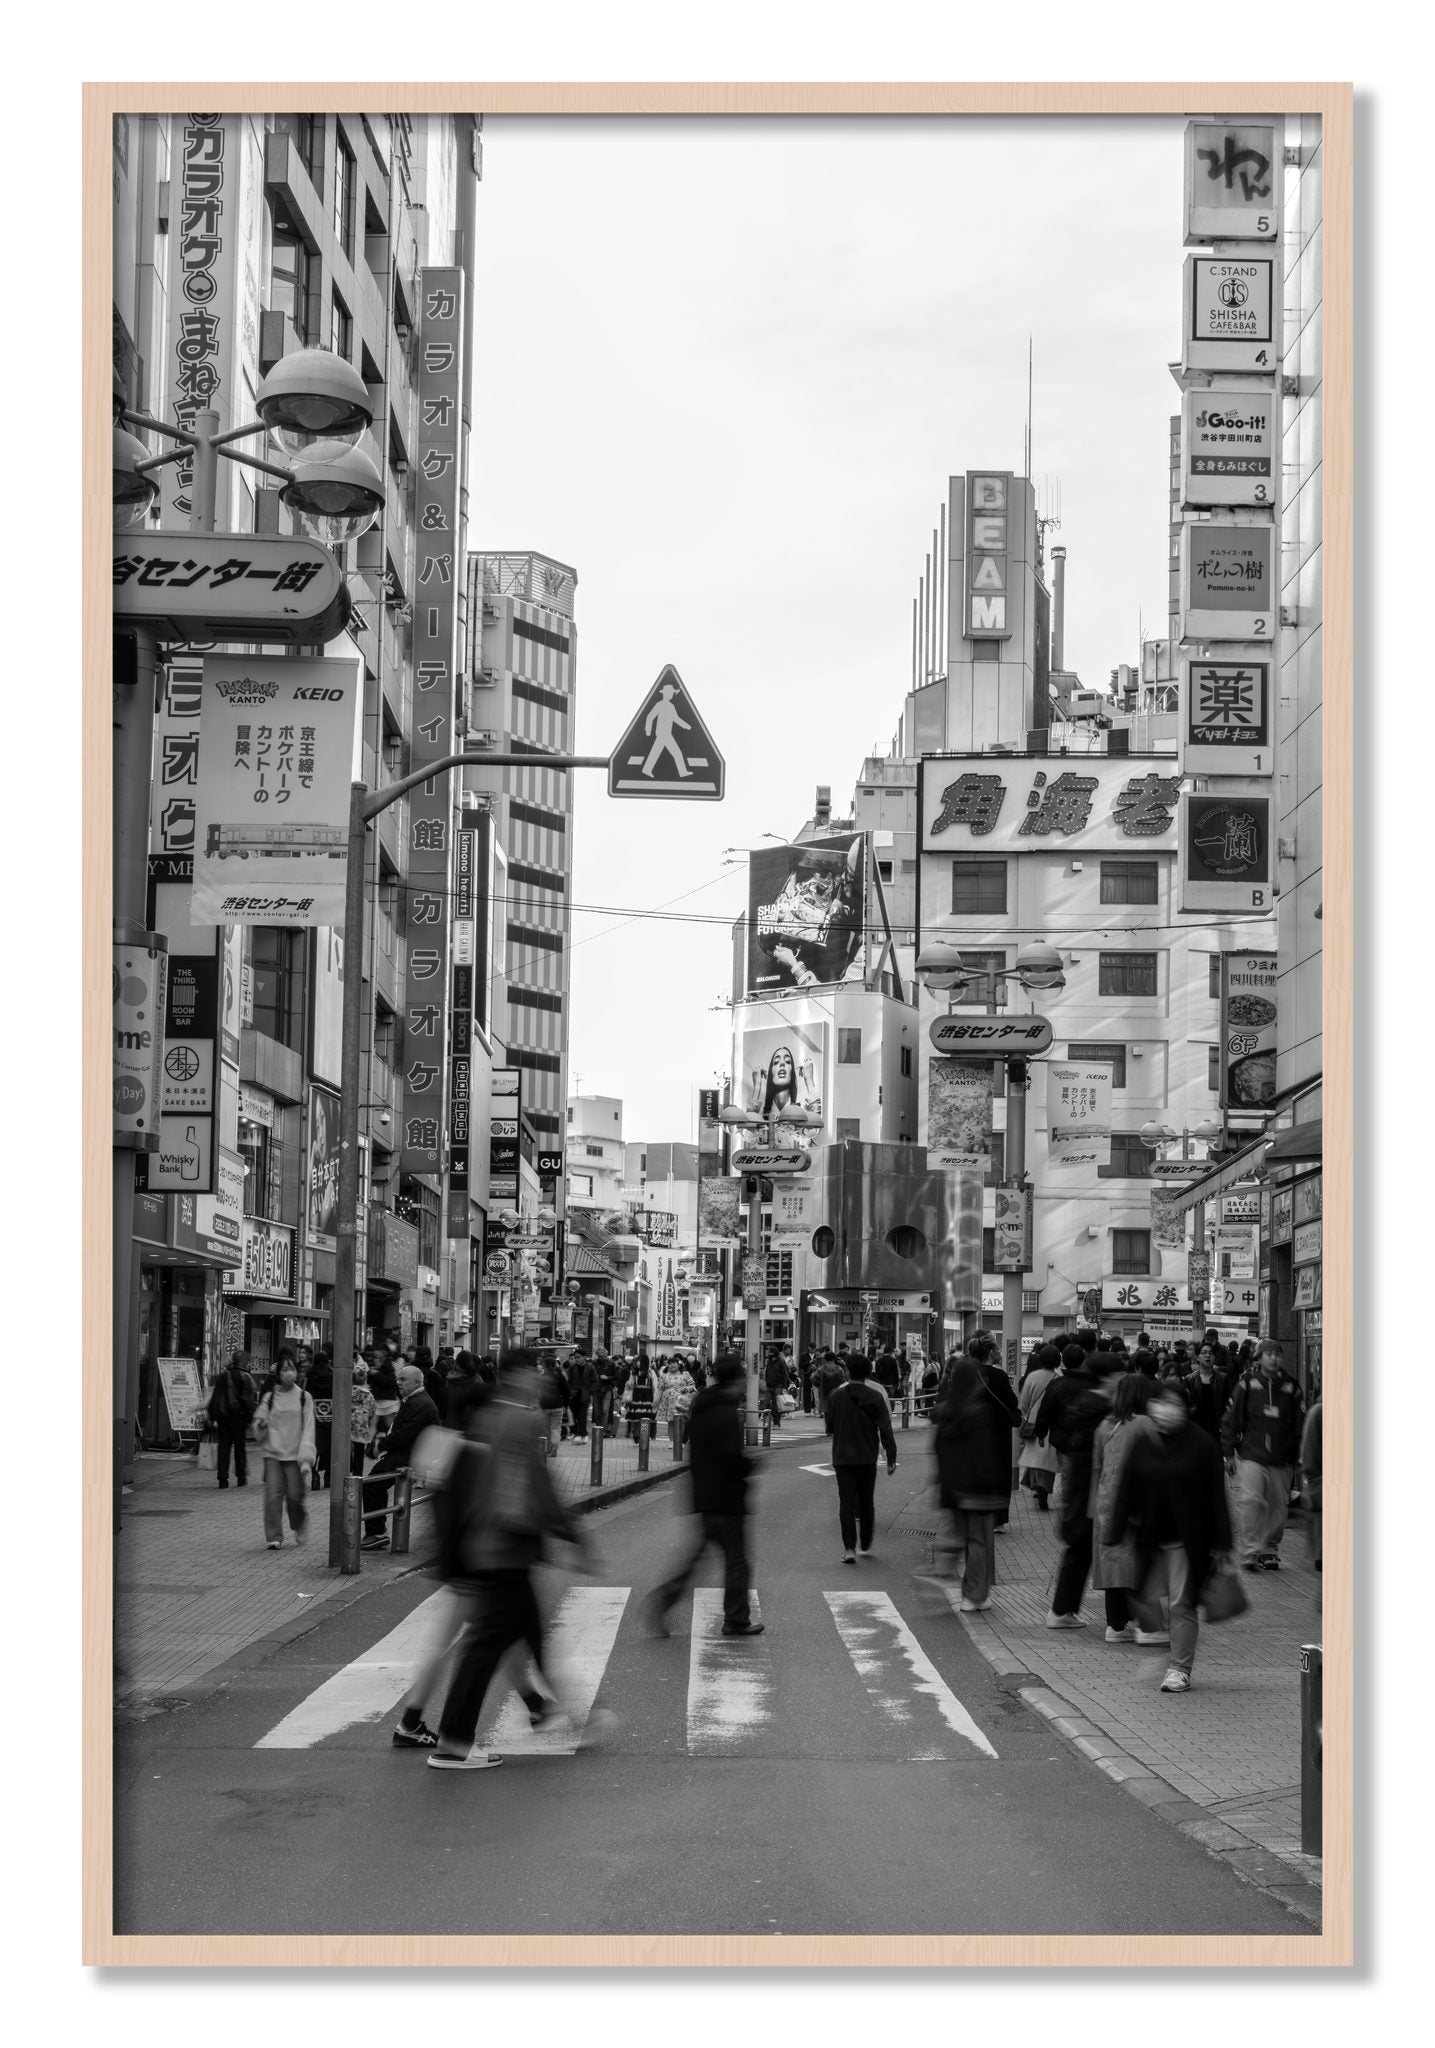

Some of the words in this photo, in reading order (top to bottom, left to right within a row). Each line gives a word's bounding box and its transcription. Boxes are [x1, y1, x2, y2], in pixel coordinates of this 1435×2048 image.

[181, 126, 225, 273] カラオケ
[1256, 216, 1269, 233] 5
[1209, 266, 1257, 278] C.STAND
[1209, 309, 1257, 321] SHISHA
[1209, 321, 1257, 330] CAFE&BAR
[1255, 350, 1268, 366] 4
[1208, 412, 1266, 430] Goo-it!
[1201, 433, 1262, 443] 渋谷宇田川町店
[1195, 460, 1267, 473] 全身もみほぐし
[1254, 484, 1267, 502] 3
[972, 476, 1008, 631] BEAM
[1196, 559, 1264, 580] ポムの樹
[1207, 584, 1255, 592] Pomme-no-ki
[1253, 619, 1266, 635] 2
[229, 696, 266, 704] KANTO
[293, 687, 344, 702] KEIO
[1200, 670, 1253, 724] 薬
[1194, 727, 1259, 742] マツモトキヨシ
[234, 725, 251, 770] 冒険へ
[253, 725, 272, 804] カントーの
[275, 725, 294, 804] ポケパーク
[298, 726, 316, 789] 京王線で
[1253, 754, 1262, 770] 1
[930, 772, 1184, 837] 角海老
[1194, 813, 1258, 865] 一蘭
[461, 835, 470, 872] kimono
[460, 878, 469, 913] hearts
[1252, 889, 1265, 907] B
[220, 897, 315, 911] 渋谷センター街
[173, 976, 196, 984] THIRD
[1230, 973, 1276, 987] 四川料理
[173, 1006, 195, 1015] ROOM
[176, 1018, 191, 1026] BAR
[405, 893, 443, 1151] カラオケ館
[938, 1025, 1046, 1039] 渋谷センター街
[1228, 1035, 1258, 1056] 6F
[122, 1086, 143, 1101] Day!
[1070, 1087, 1078, 1118] カントーの
[503, 1127, 517, 1136] UP
[160, 1154, 195, 1166] Whisky
[540, 1157, 561, 1169] GU
[159, 1164, 181, 1174] Bank
[1117, 1284, 1179, 1307] 兆楽
[664, 1282, 675, 1327] BEER
